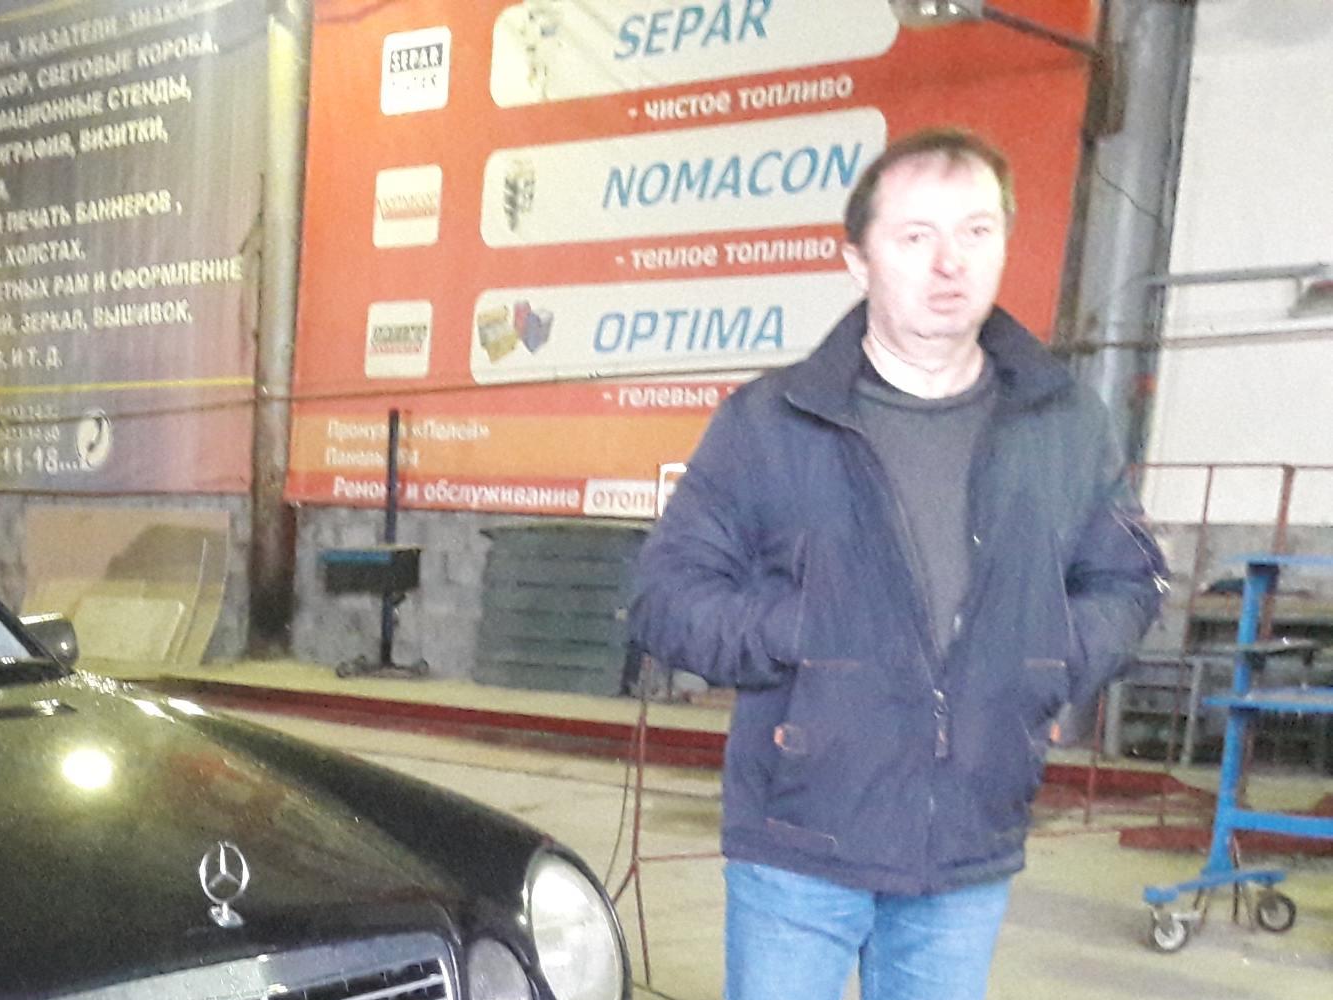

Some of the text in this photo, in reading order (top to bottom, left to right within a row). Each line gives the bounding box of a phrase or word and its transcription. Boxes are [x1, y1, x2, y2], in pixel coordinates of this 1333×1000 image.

[614, 0, 772, 60] SEPAR
[37, 50, 133, 90] СВЕТОВЫЕ
[136, 30, 220, 68] КОРОБА,
[107, 73, 192, 112] СТЕНДЫ,
[644, 75, 854, 121] чистое топливо
[78, 115, 169, 153] ВИЗИТКИ,
[602, 142, 863, 210] NOMACON
[5, 204, 72, 234] ПЕЧАТЬ
[631, 236, 837, 271] теплое топливо
[53, 272, 90, 297] РАМ
[92, 270, 107, 294] И
[110, 255, 245, 293] ОФОРМЛЕНИЕ
[20, 308, 89, 335] ЗЕРКАЛ,
[593, 304, 785, 353] OPTIMA
[11, 347, 24, 369] И
[618, 386, 719, 408] гелевые
[332, 474, 402, 499] Ремон
[423, 477, 580, 508] обслуживание
